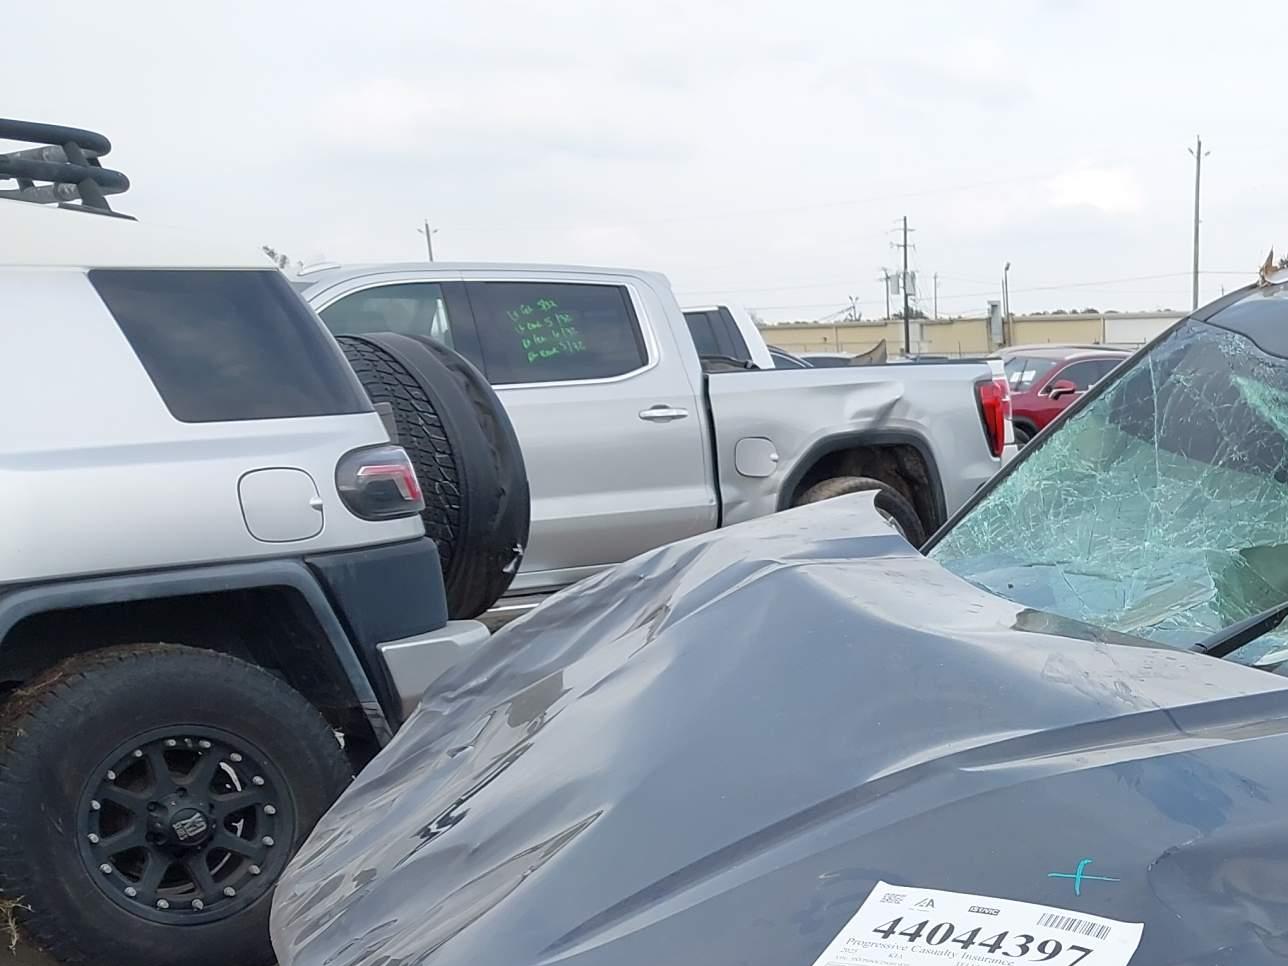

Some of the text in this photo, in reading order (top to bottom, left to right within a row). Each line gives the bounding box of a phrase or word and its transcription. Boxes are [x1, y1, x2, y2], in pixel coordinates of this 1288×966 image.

[846, 936, 1015, 966] Progressive Casualty Insurance
